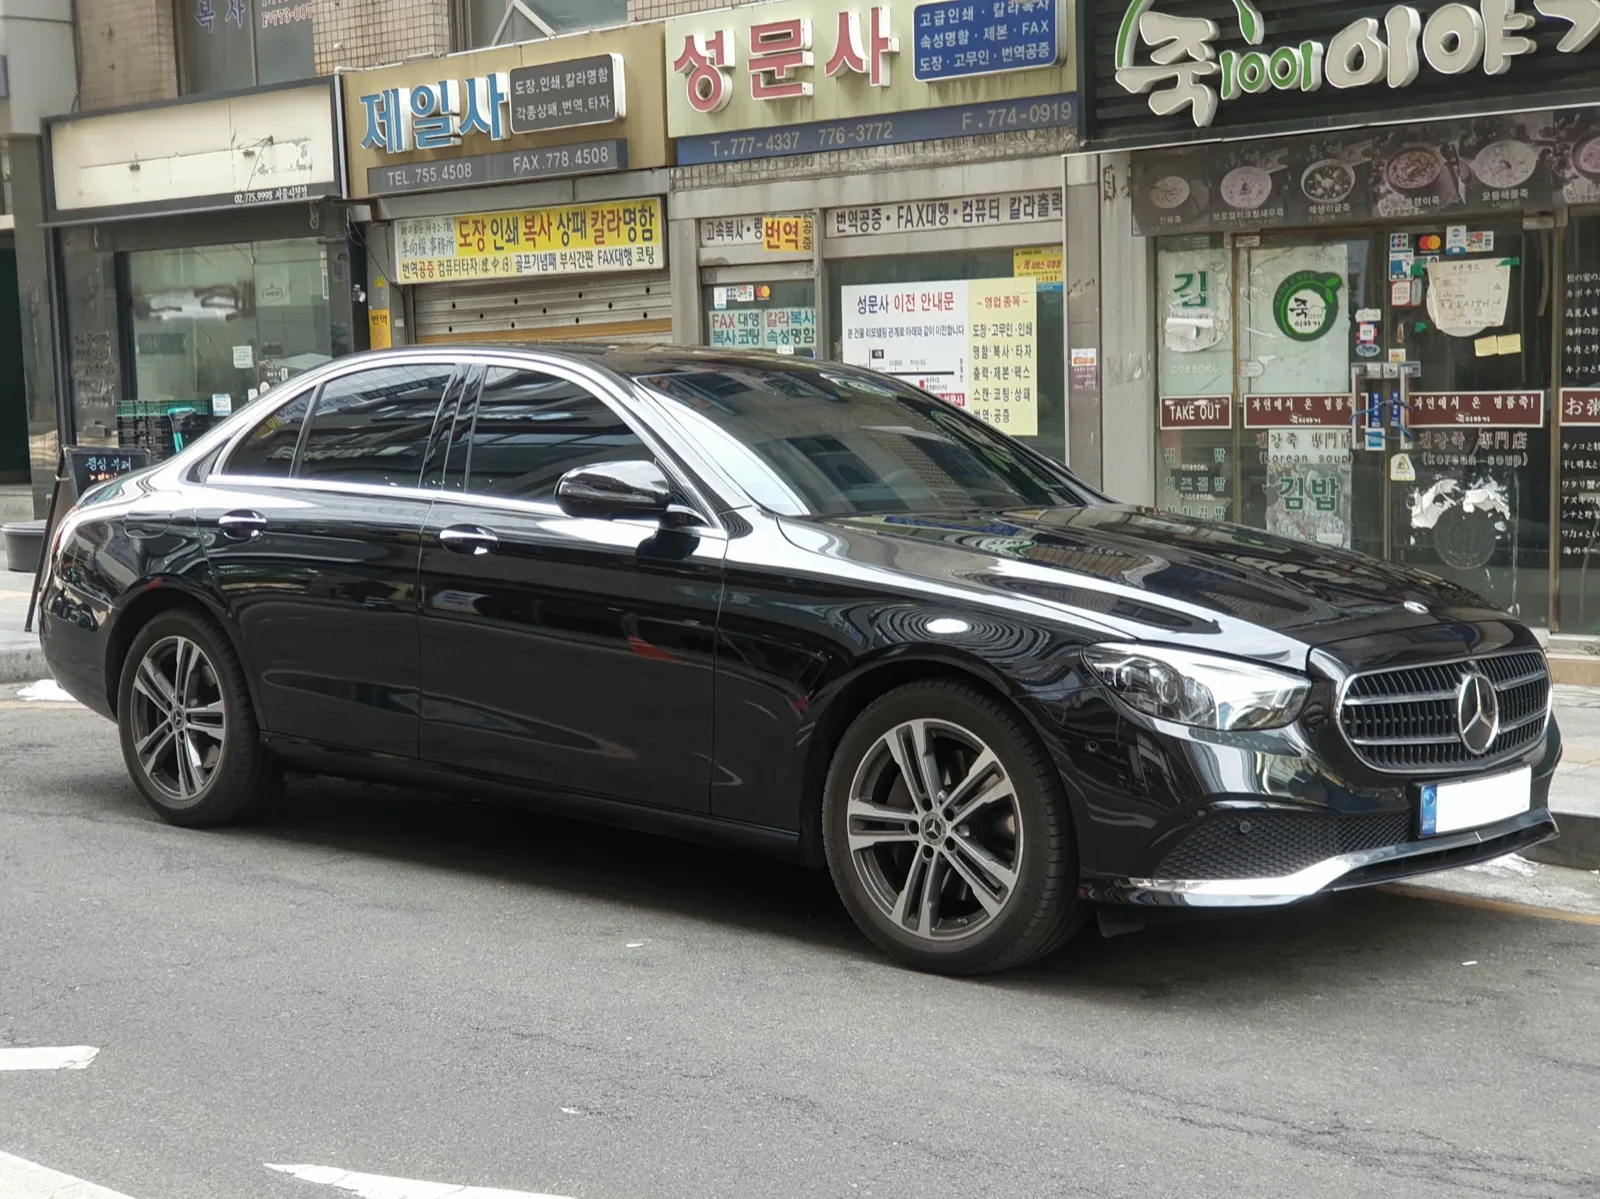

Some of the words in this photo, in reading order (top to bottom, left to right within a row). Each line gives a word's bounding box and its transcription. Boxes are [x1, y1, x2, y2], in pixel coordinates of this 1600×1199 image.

[920, 6, 974, 27] 고급인쇄
[920, 29, 969, 50] 속성명함
[983, 24, 1008, 42] 제본
[1022, 19, 1049, 36] FAX
[672, 6, 899, 113] 성문사
[919, 56, 943, 72] 도장
[954, 50, 990, 67] 고무인
[1001, 42, 1050, 62] 번역공증
[360, 72, 508, 153] 제일사
[711, 132, 800, 157] T.777-4337
[818, 121, 893, 146] 776-3772
[387, 163, 472, 186] TEL.755.4508
[512, 146, 609, 173] FAX.778.4508
[836, 208, 882, 233] 번역공증
[897, 202, 949, 229] FAX대행
[962, 197, 1000, 224] 컴퓨터
[459, 218, 486, 252] 도장
[490, 216, 519, 251] 인쇄
[523, 213, 553, 248] 복사
[556, 209, 587, 247] 상패
[706, 219, 744, 242] 고속복사
[765, 220, 799, 250] 번역
[402, 260, 435, 279] 번역공증
[515, 252, 557, 273] 골프기념패
[560, 249, 594, 270] 부식간판
[597, 246, 633, 267] FAX대행
[636, 246, 655, 265] 코팅
[857, 294, 889, 315] 성문사
[893, 293, 915, 313] 이전
[920, 291, 954, 312] 안내문
[984, 296, 1001, 309] 영업
[1289, 297, 1309, 319] 죽
[712, 313, 735, 329] FAX
[738, 312, 760, 328] 대행
[713, 329, 736, 346] 복사
[738, 329, 760, 345] 코팅
[1169, 405, 1195, 421] TAKE
[1199, 404, 1221, 420] OUT
[1471, 396, 1481, 409] 온
[1278, 476, 1341, 512] 김밥
